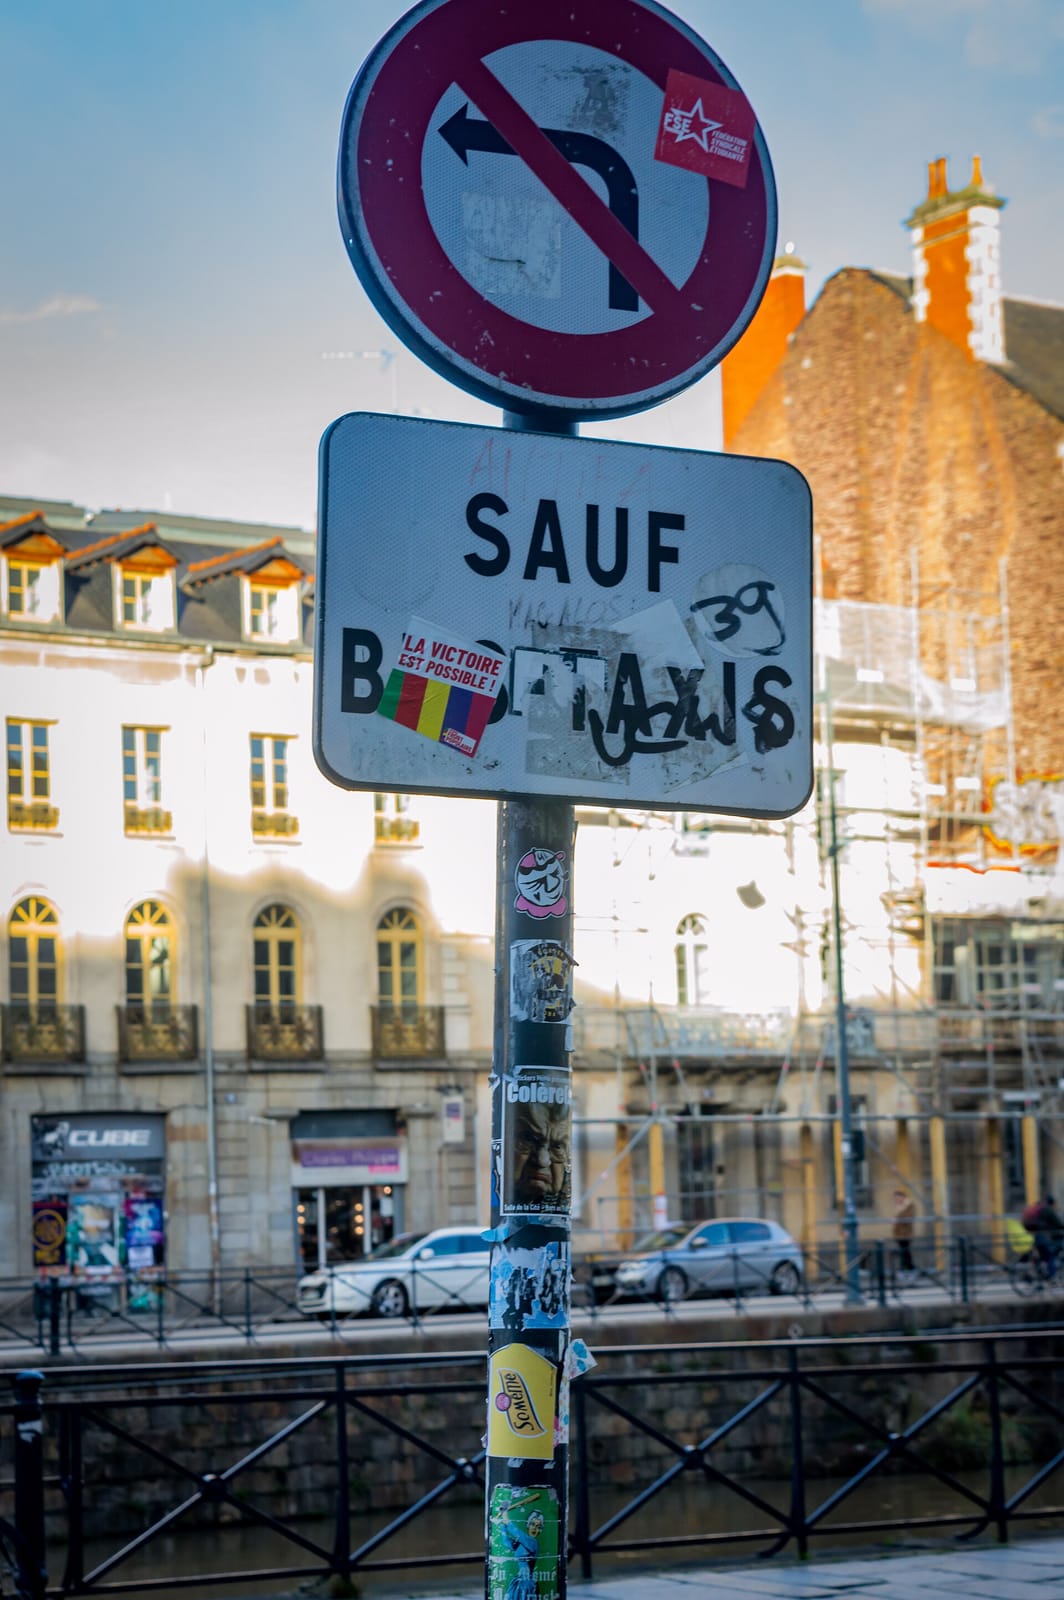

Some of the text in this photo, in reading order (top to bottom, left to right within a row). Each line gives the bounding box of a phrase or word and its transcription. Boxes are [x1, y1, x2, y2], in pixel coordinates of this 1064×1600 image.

[664, 112, 692, 133] FSE
[463, 492, 685, 592] SAUF
[398, 653, 426, 670] EST
[425, 660, 489, 690] POSSIBLE
[404, 634, 503, 676] LA VICTOIRE
[68, 1129, 151, 1147] CUBE
